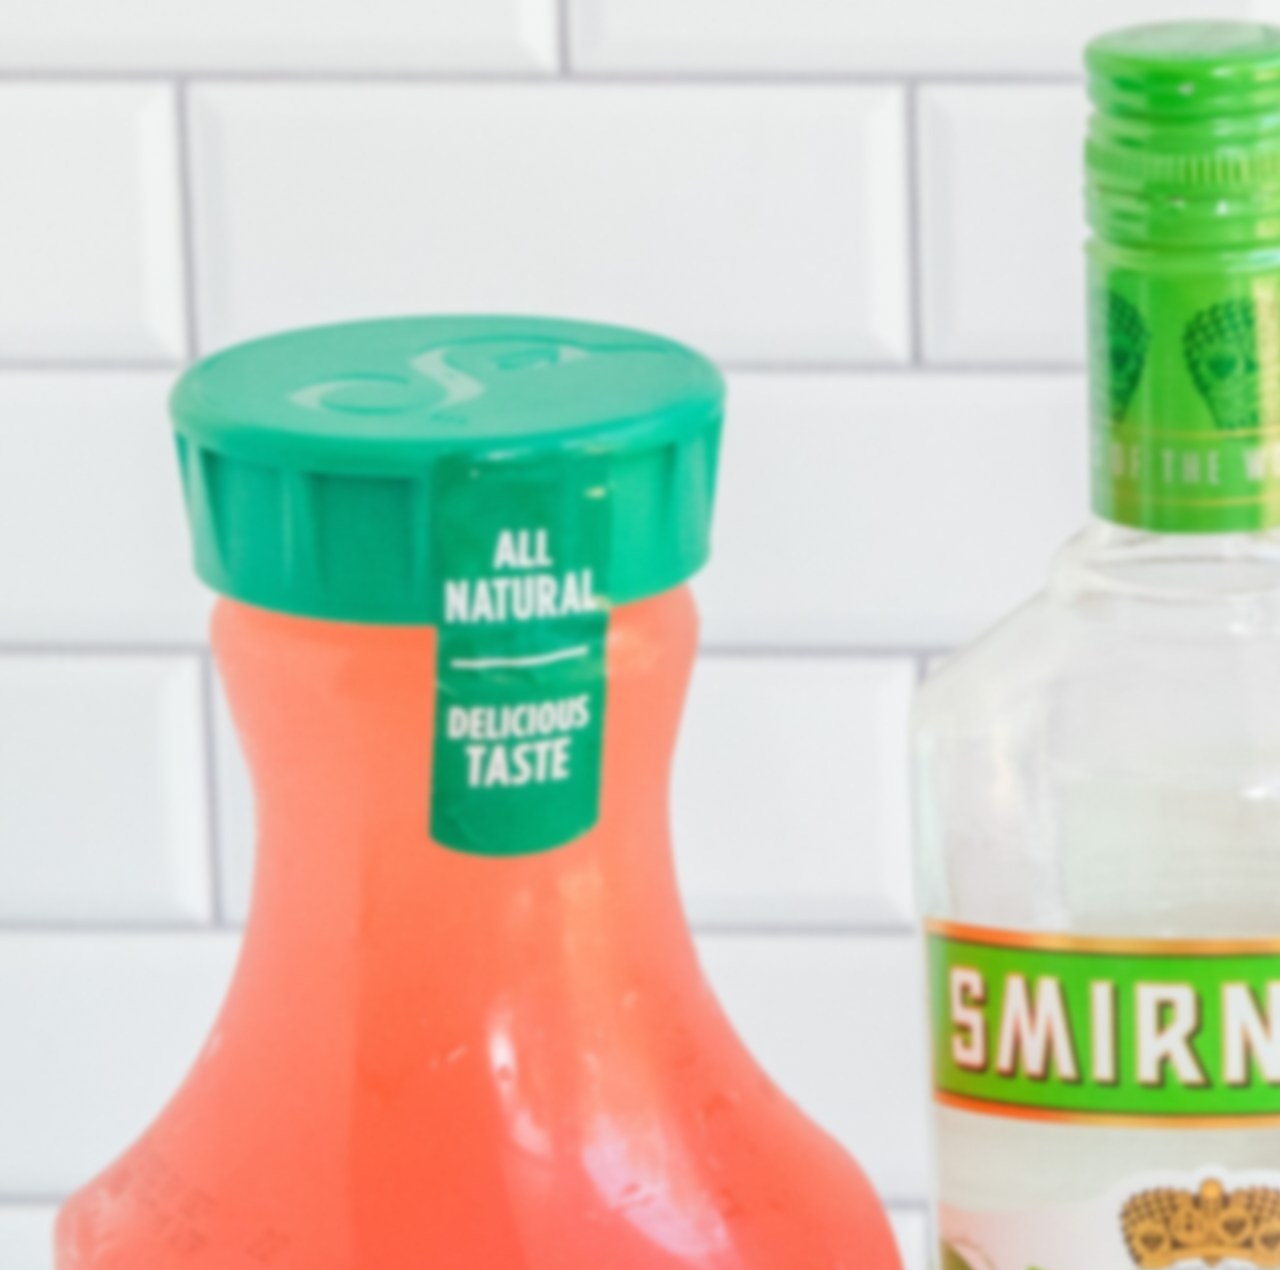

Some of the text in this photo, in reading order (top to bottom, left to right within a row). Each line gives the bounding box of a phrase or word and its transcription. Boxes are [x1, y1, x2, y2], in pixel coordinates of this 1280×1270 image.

[1162, 448, 1219, 486] THE
[493, 529, 553, 570] ALL
[444, 568, 598, 624] NATURAL
[446, 694, 591, 740] DELICIOUS
[465, 736, 572, 789] TASTE
